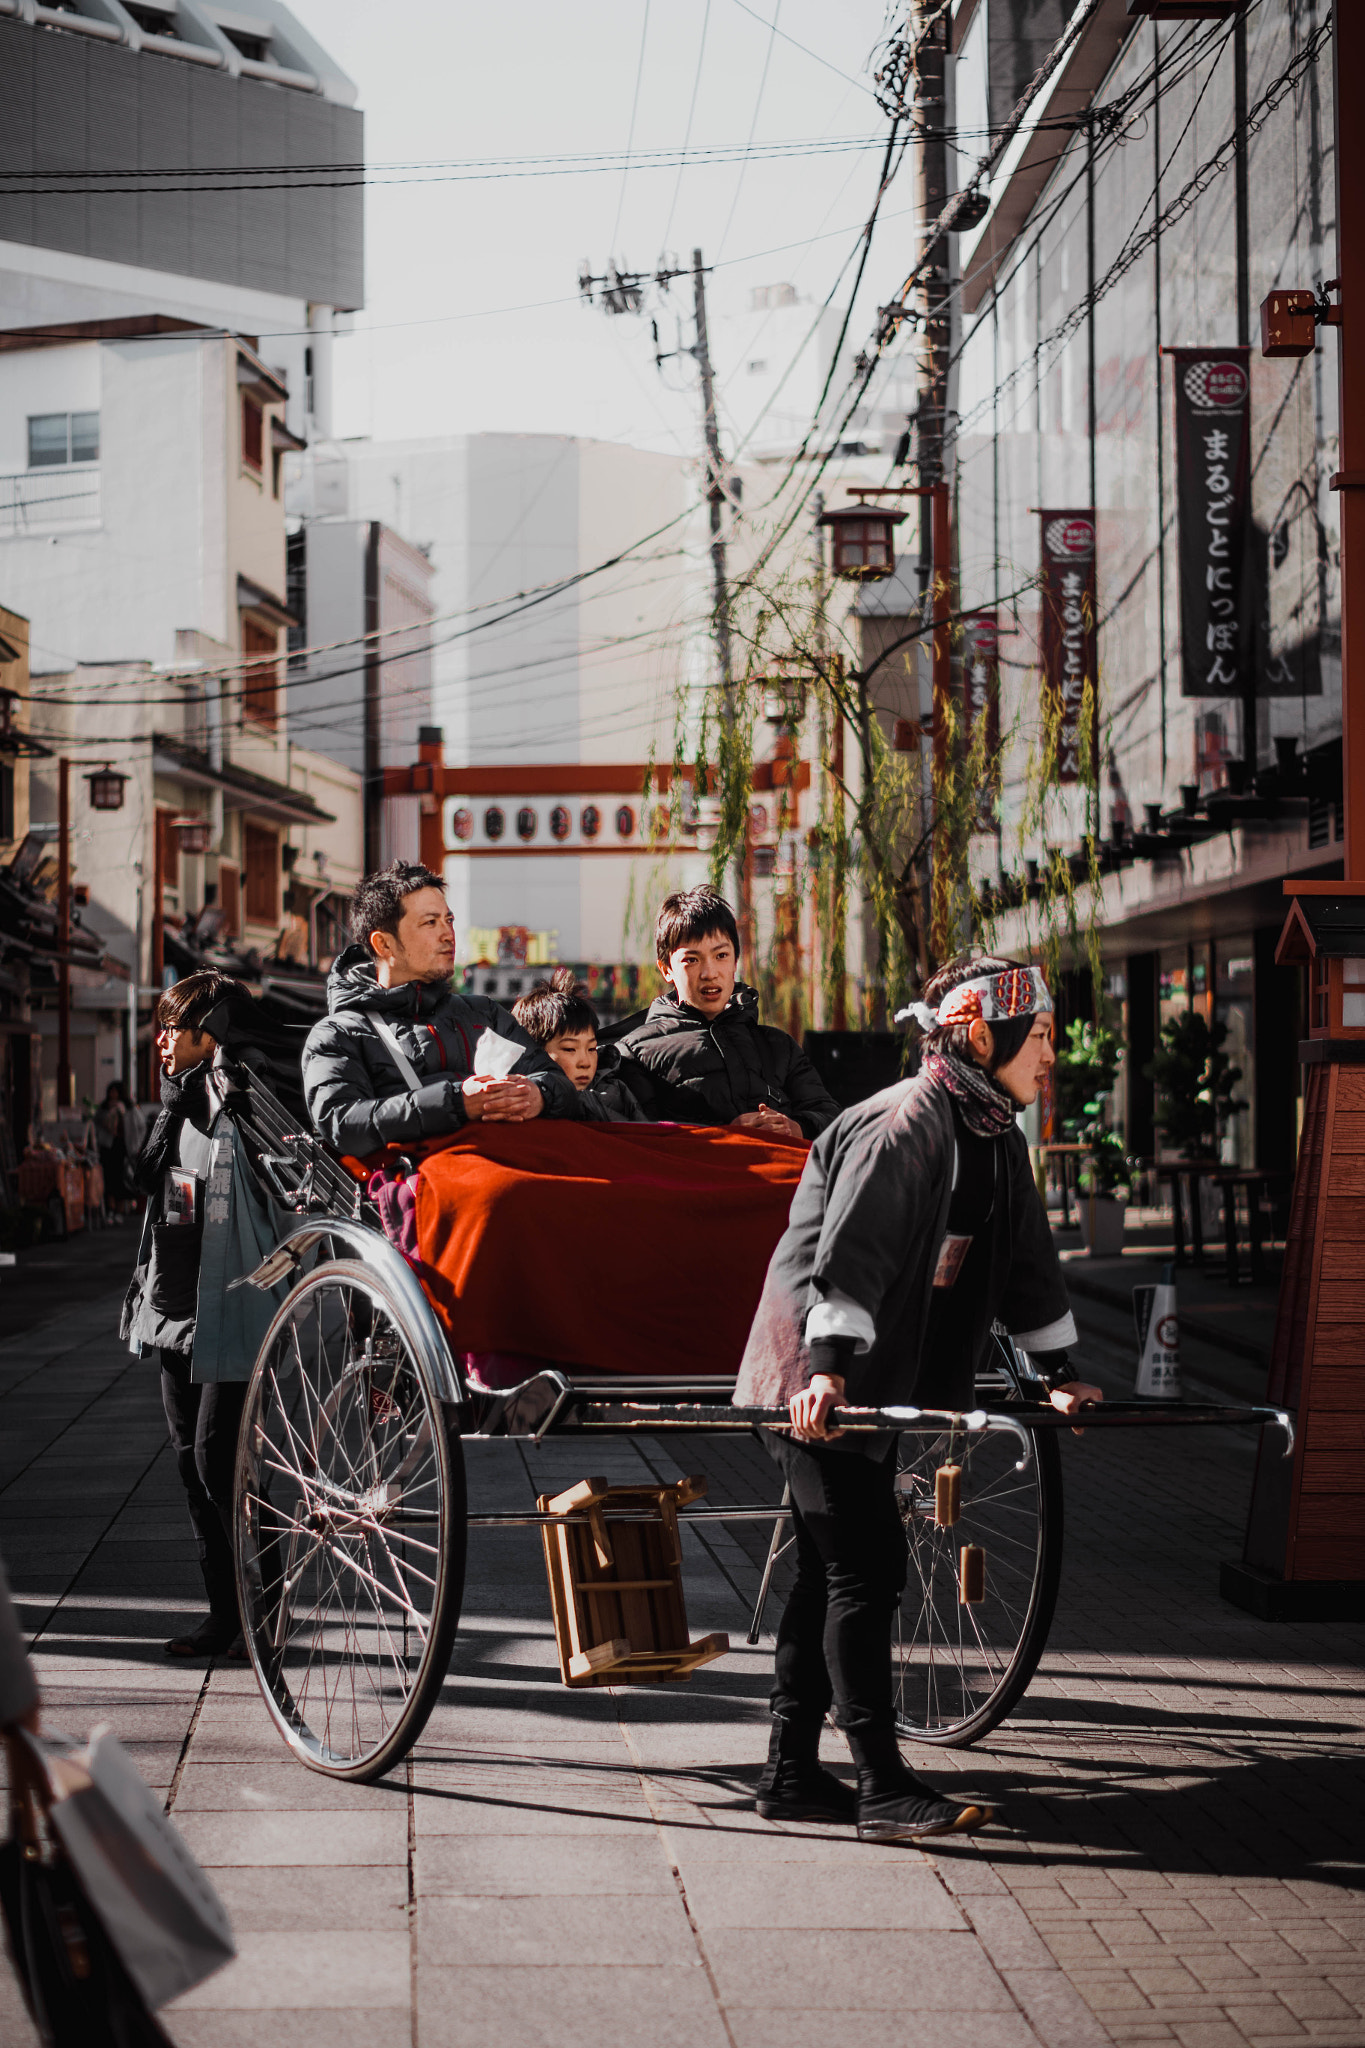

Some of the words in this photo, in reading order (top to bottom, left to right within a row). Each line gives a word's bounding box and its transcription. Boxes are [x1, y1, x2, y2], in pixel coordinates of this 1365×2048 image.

[1203, 429, 1238, 684] まるごとにっぽん
